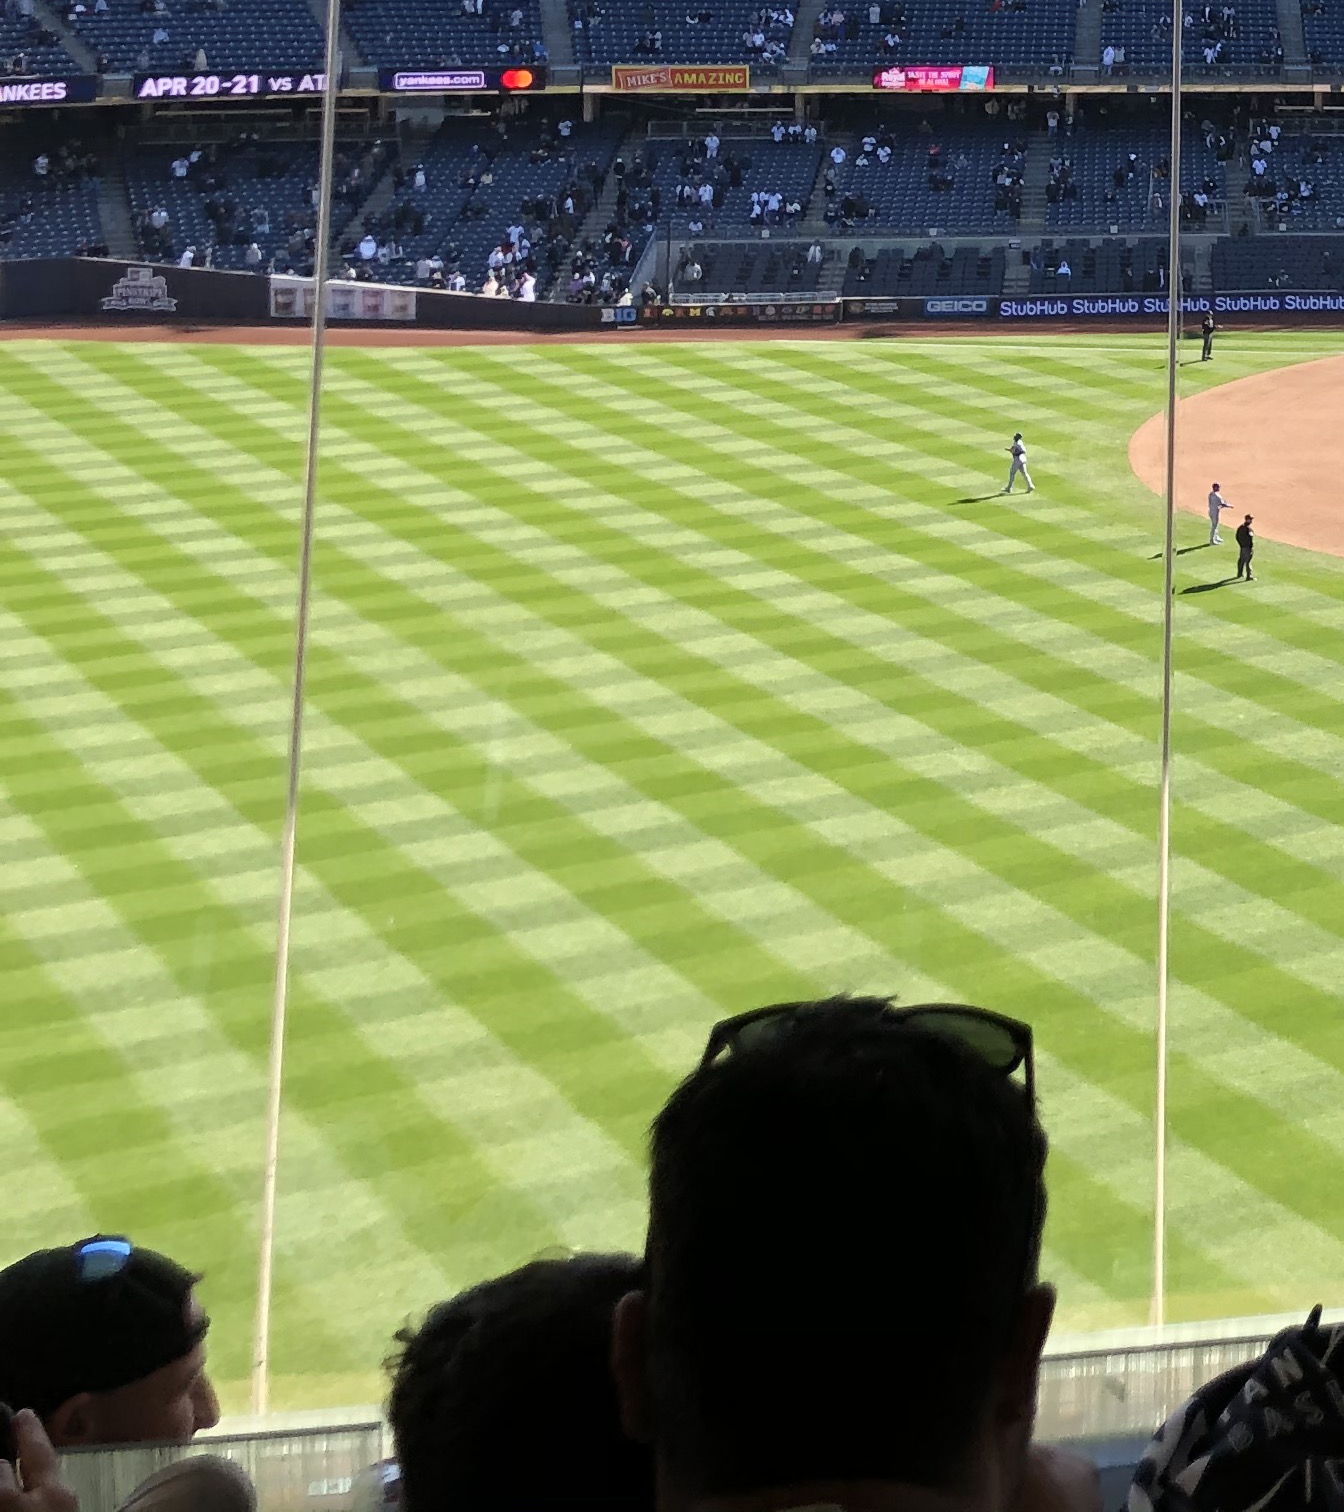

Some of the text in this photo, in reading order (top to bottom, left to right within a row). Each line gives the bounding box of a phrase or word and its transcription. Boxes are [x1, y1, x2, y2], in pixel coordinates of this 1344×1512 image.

[138, 77, 187, 98] APR
[190, 75, 260, 95] 20-21
[398, 73, 481, 87] yankees.com
[626, 70, 746, 87] MIKE'S AMAZING
[0, 82, 67, 102] NKEES
[926, 300, 987, 312] GEICO
[1000, 299, 1067, 316] StubHub
[1072, 298, 1138, 314] StubHub
[1144, 297, 1210, 313] StuHub
[1215, 296, 1280, 311] StubHub
